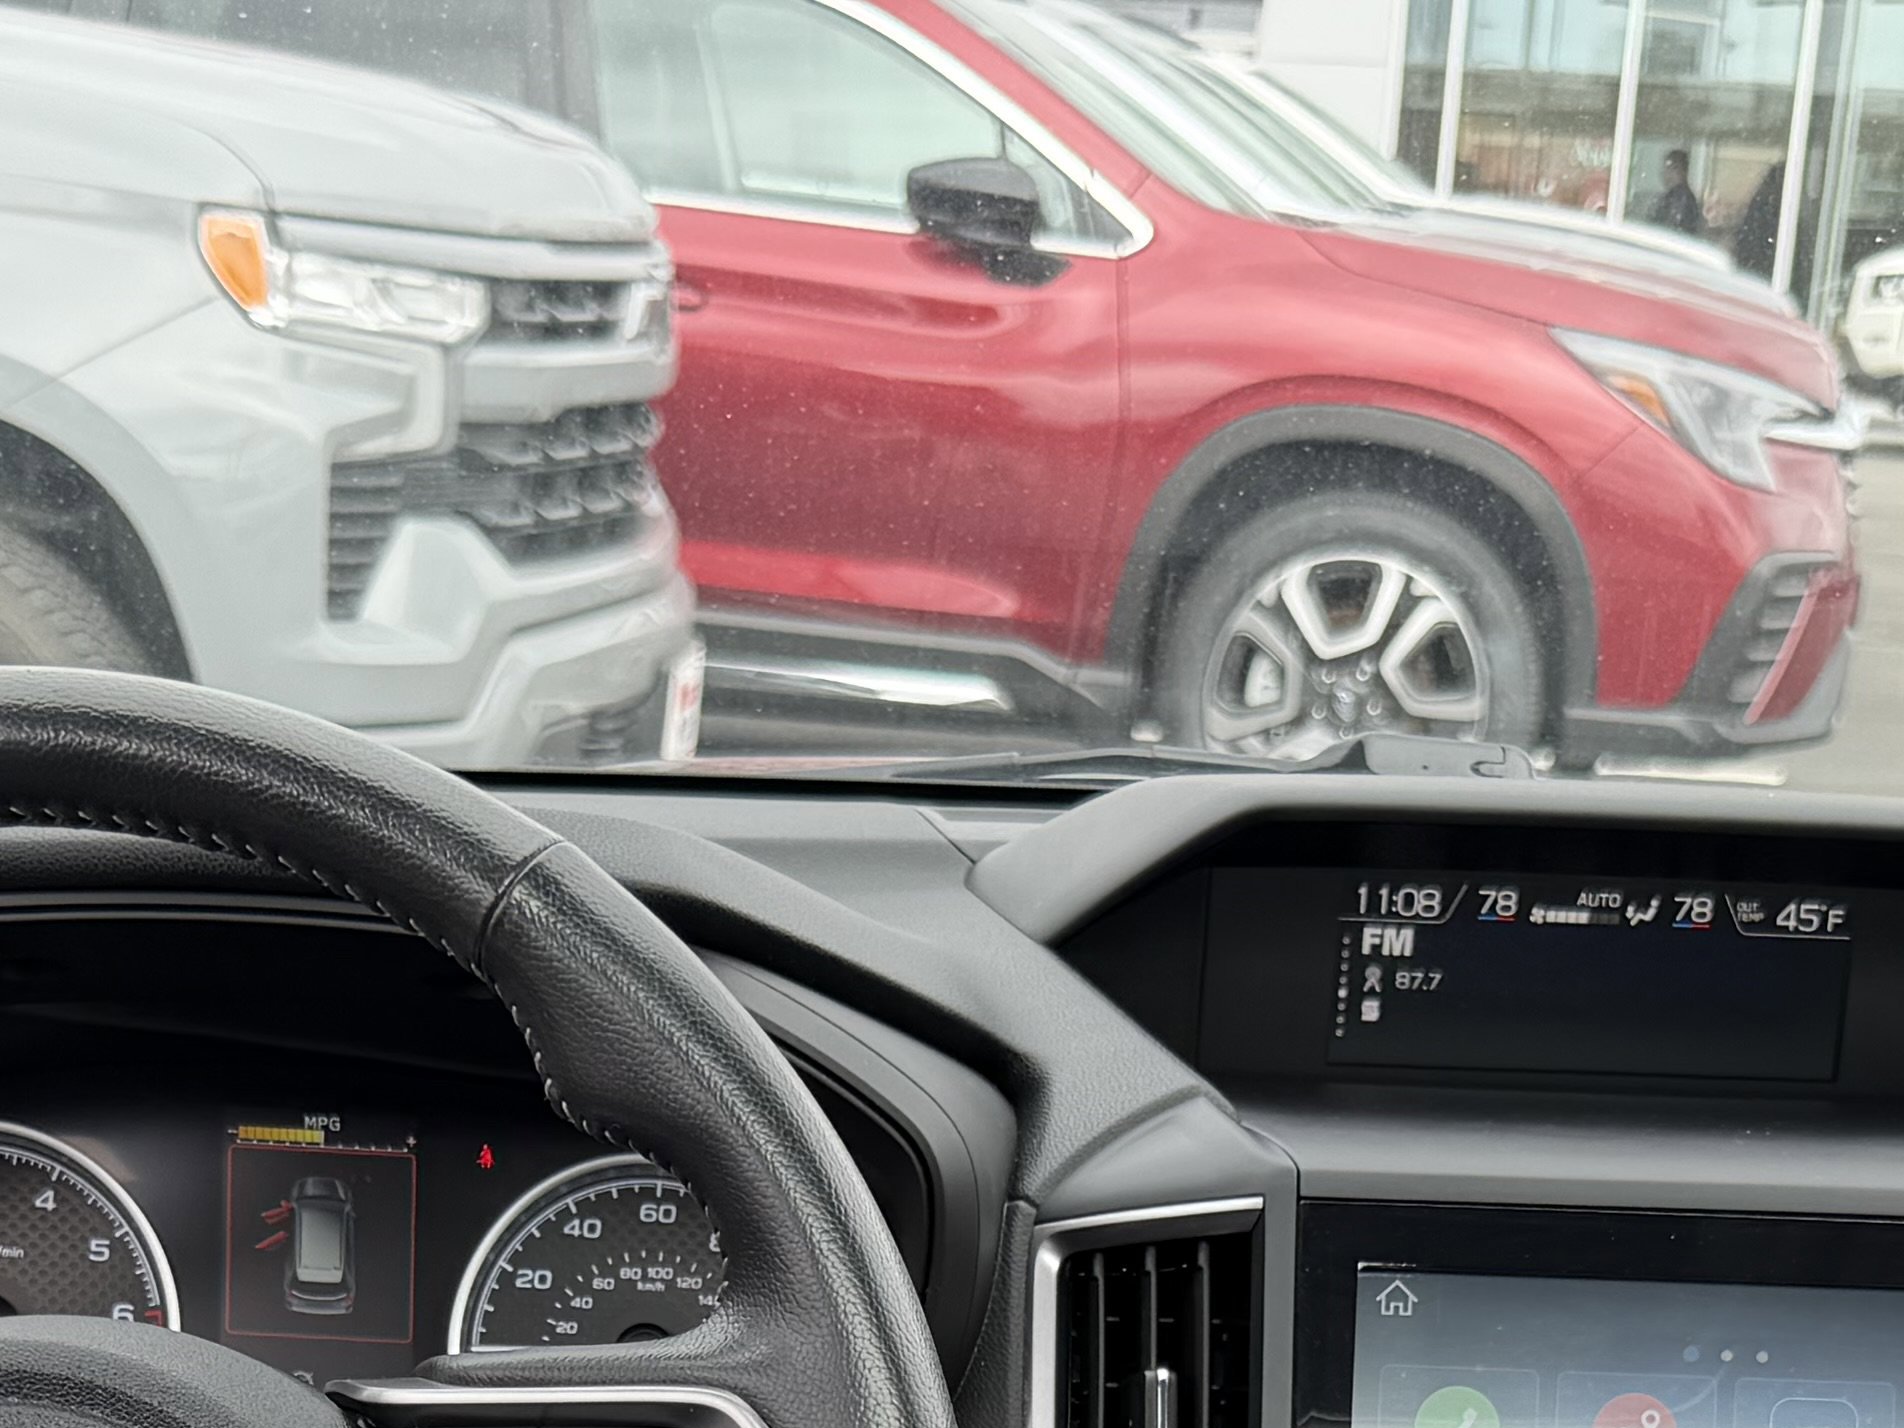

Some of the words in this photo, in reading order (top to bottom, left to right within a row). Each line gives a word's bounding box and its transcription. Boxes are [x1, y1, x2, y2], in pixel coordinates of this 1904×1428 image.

[1357, 884, 1442, 918] 11:08
[1478, 889, 1518, 917] 78
[1576, 892, 1622, 908] AUTO
[1674, 896, 1714, 923] 78
[1361, 926, 1415, 957] FM
[1395, 971, 1443, 991] 87.7
[304, 1115, 342, 1132] MPG
[34, 1190, 58, 1212] 4
[639, 1204, 677, 1223] 60
[563, 1218, 602, 1238] 40
[89, 1239, 111, 1262] 5
[515, 1270, 553, 1290] 20
[619, 1267, 641, 1280] 80
[647, 1266, 673, 1280] 100
[592, 1278, 614, 1290] 60
[637, 1281, 665, 1293] km/h
[676, 1277, 703, 1290] 120
[570, 1296, 593, 1309] 40
[698, 1295, 720, 1306] 14
[555, 1322, 578, 1335] 20
